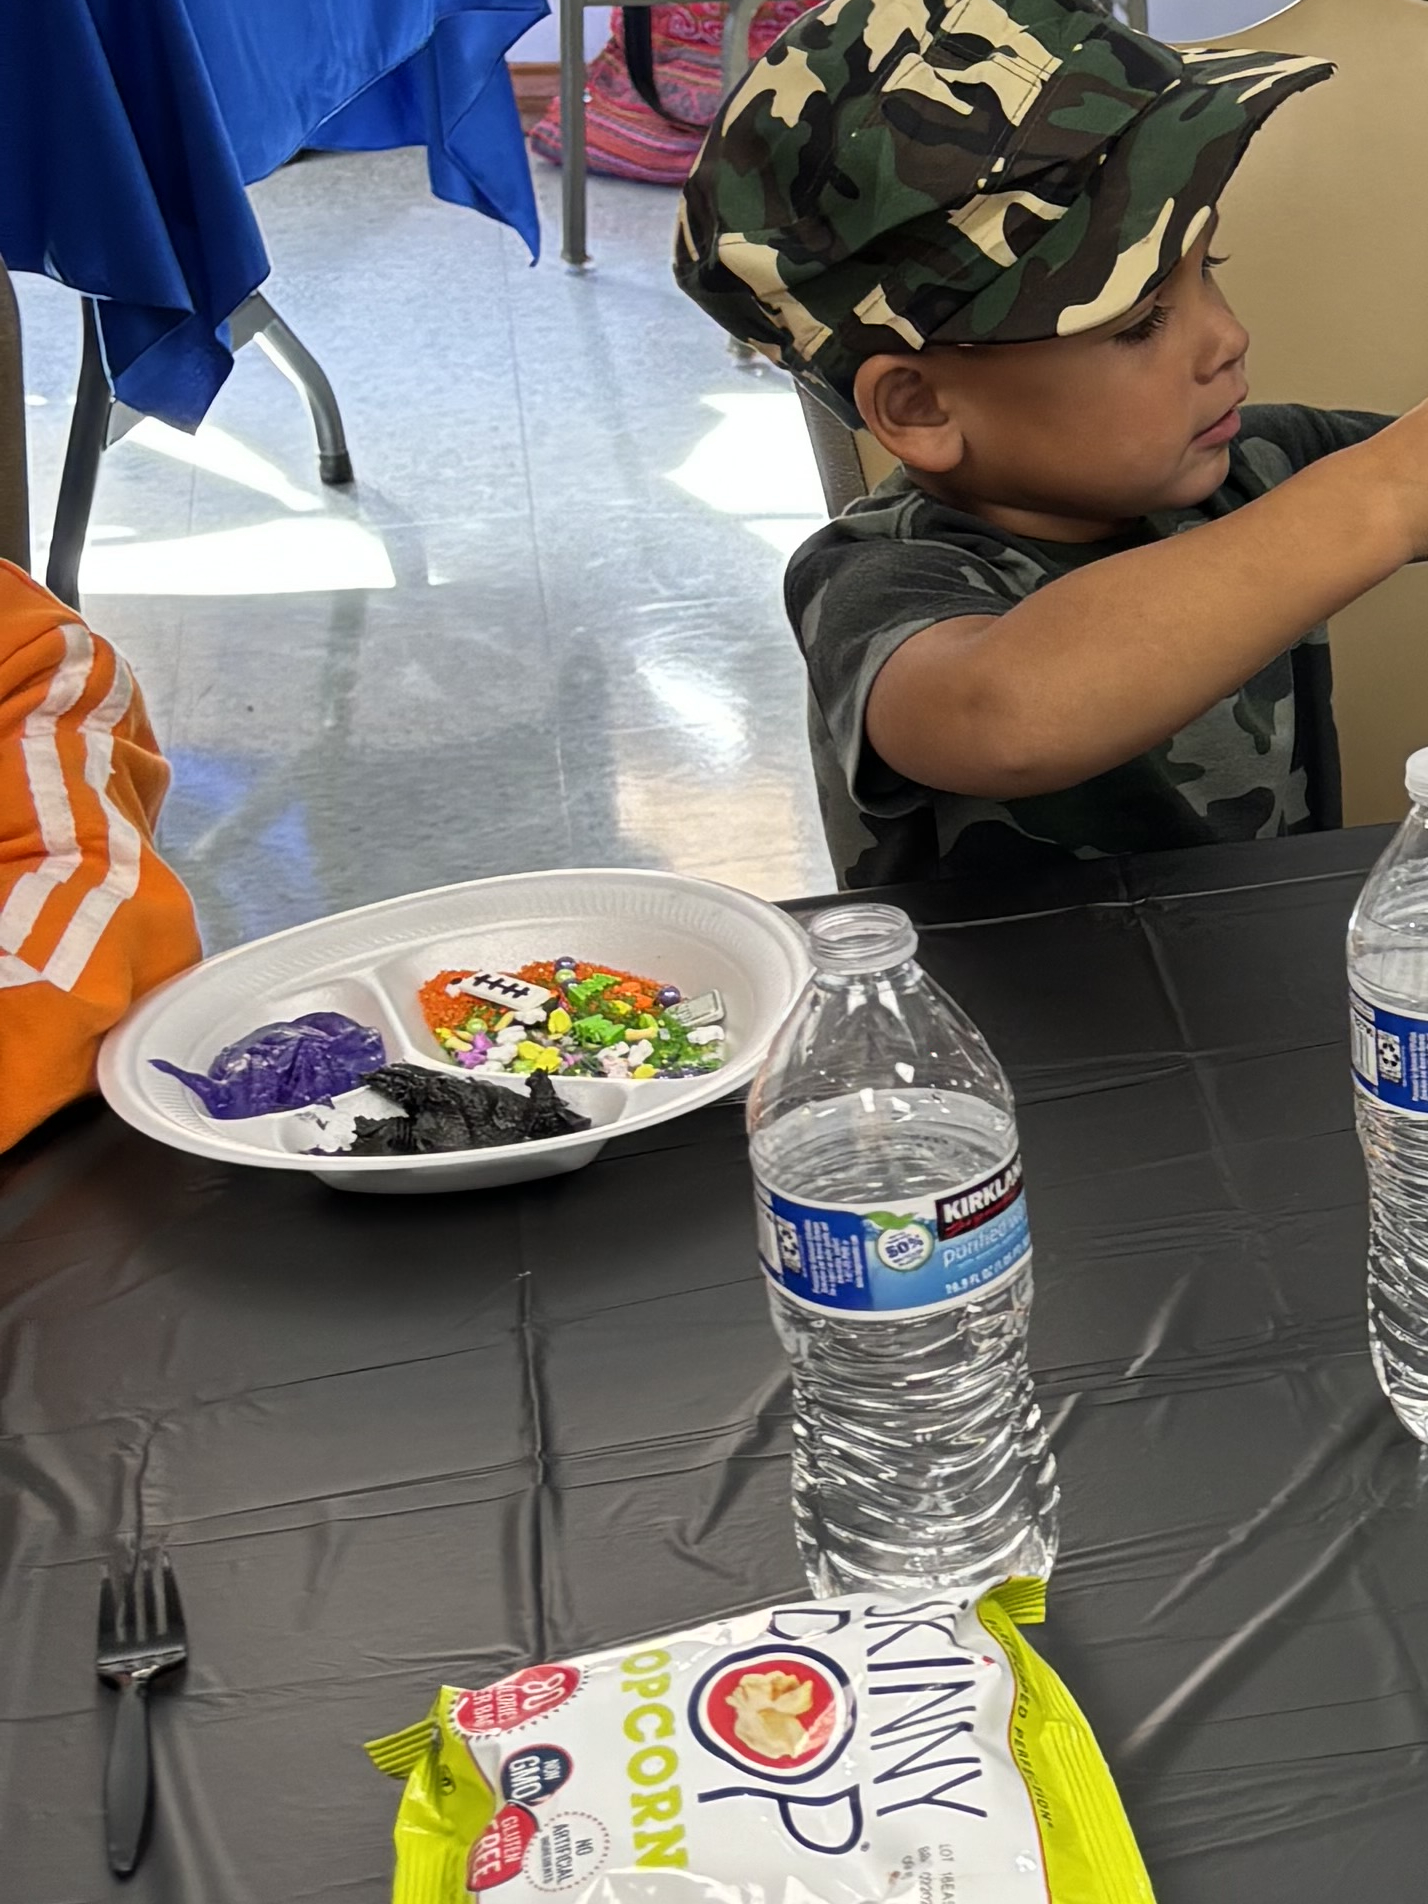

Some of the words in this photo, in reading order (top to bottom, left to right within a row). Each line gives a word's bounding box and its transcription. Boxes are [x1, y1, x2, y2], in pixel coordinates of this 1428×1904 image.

[885, 1237, 924, 1258] 50%
[473, 1689, 493, 1706] ER
[520, 1672, 566, 1712] 80
[864, 1600, 988, 1818] SKINNY
[688, 1608, 863, 1856] POP
[508, 1754, 543, 1801] GMO
[542, 1757, 561, 1781] NON
[620, 1649, 689, 1870] OPCORN
[501, 1814, 522, 1866] GLUTEN
[552, 1822, 575, 1886] ARTIFICIAL
[574, 1838, 595, 1857] NO
